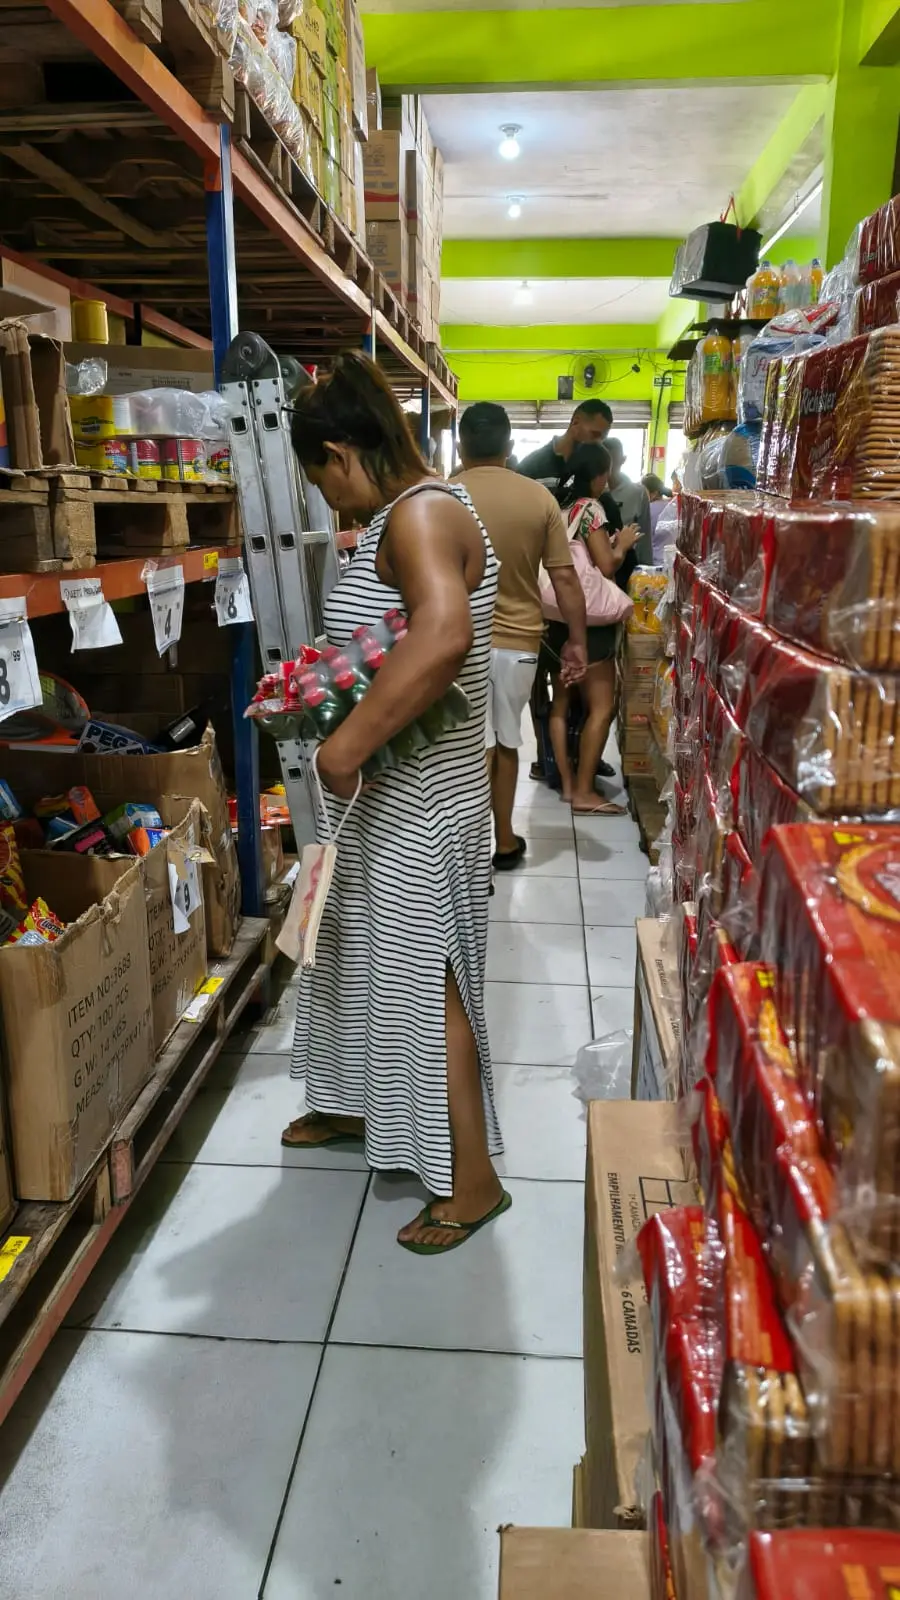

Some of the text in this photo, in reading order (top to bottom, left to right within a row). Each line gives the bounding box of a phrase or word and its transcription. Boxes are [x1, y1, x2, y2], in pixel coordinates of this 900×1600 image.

[165, 608, 172, 638] 4
[228, 591, 238, 619] 8
[86, 724, 129, 748] PEG
[67, 992, 95, 1028] ITEM
[71, 982, 130, 1059] QTY: 100 PCS
[74, 1015, 127, 1088] G.W: 14 KGS
[75, 1074, 104, 1114] MEAS:
[607, 1172, 626, 1243] EMPILHAMENTO
[620, 1290, 633, 1298] 6
[621, 1300, 641, 1354] CAMADAS
